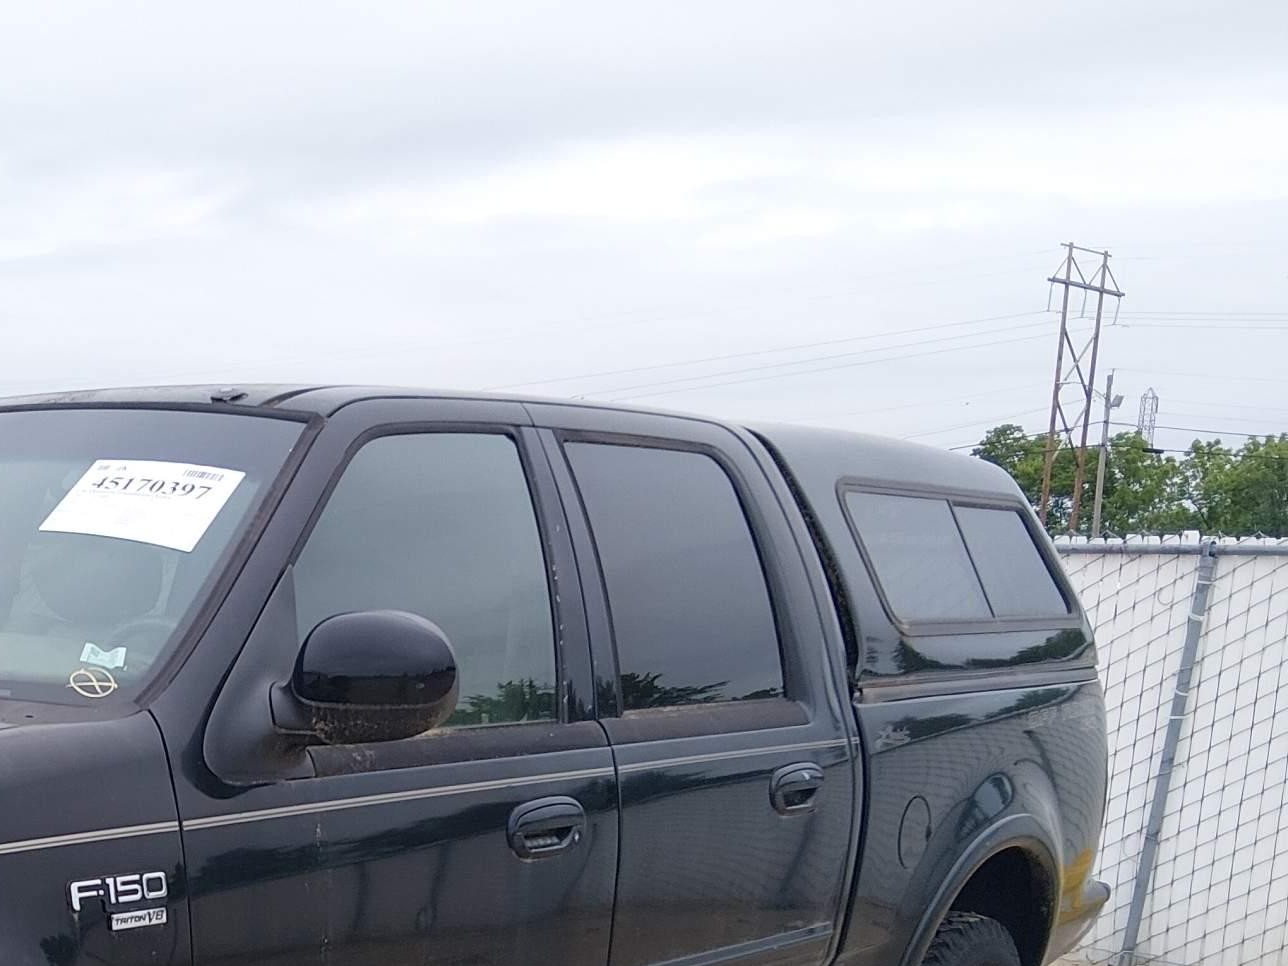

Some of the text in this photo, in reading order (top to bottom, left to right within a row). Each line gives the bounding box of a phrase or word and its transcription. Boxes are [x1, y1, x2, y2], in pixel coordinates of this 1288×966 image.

[92, 476, 213, 500] 45170397
[114, 909, 165, 926] TRITON V8
